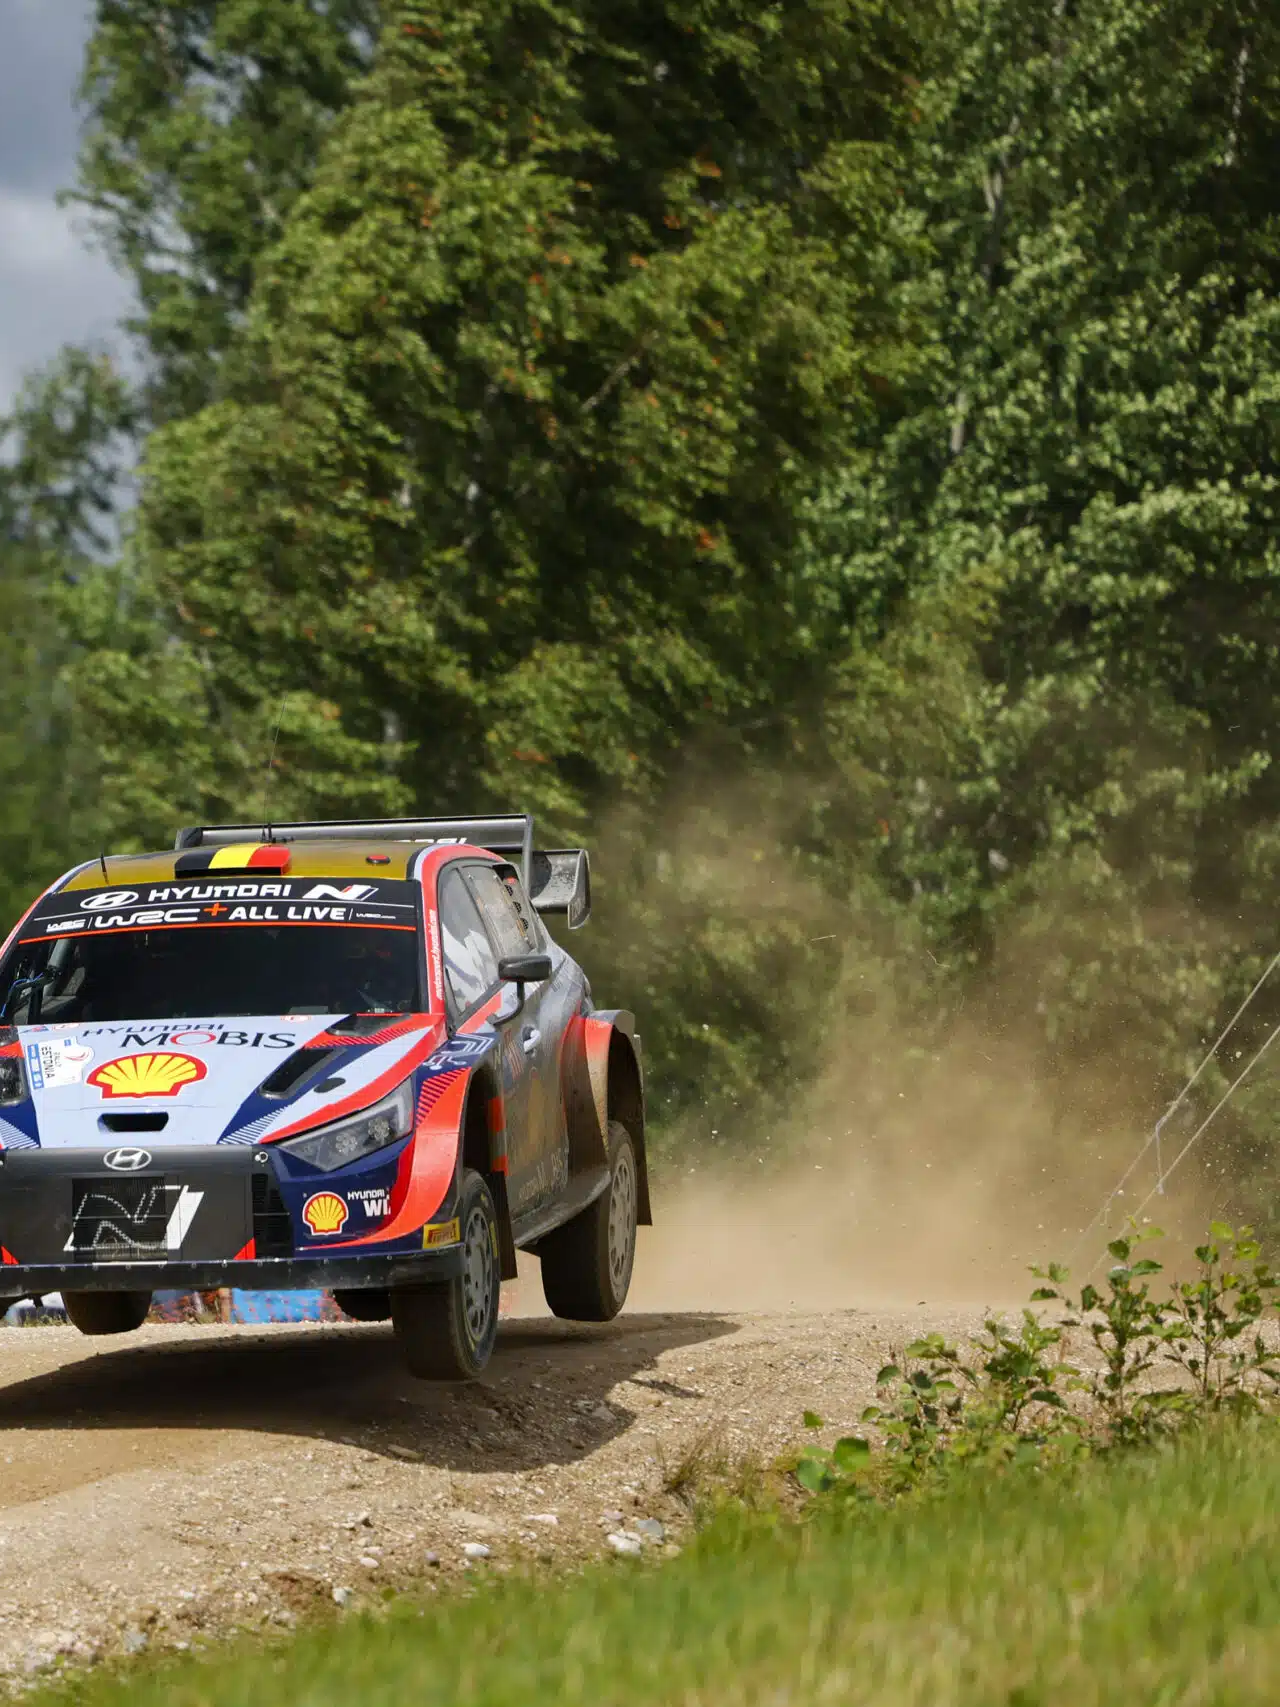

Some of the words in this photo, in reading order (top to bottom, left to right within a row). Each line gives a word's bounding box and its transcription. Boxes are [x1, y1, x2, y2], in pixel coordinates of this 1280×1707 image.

[148, 884, 292, 902] HYUNDAI
[229, 906, 279, 920] ALL
[287, 907, 347, 921] LIVE
[82, 1023, 225, 1037] HYUNDAI
[120, 1031, 296, 1049] MOBIS
[41, 1046, 55, 1079] ESTONIA
[347, 1189, 385, 1200] HYUNDAI
